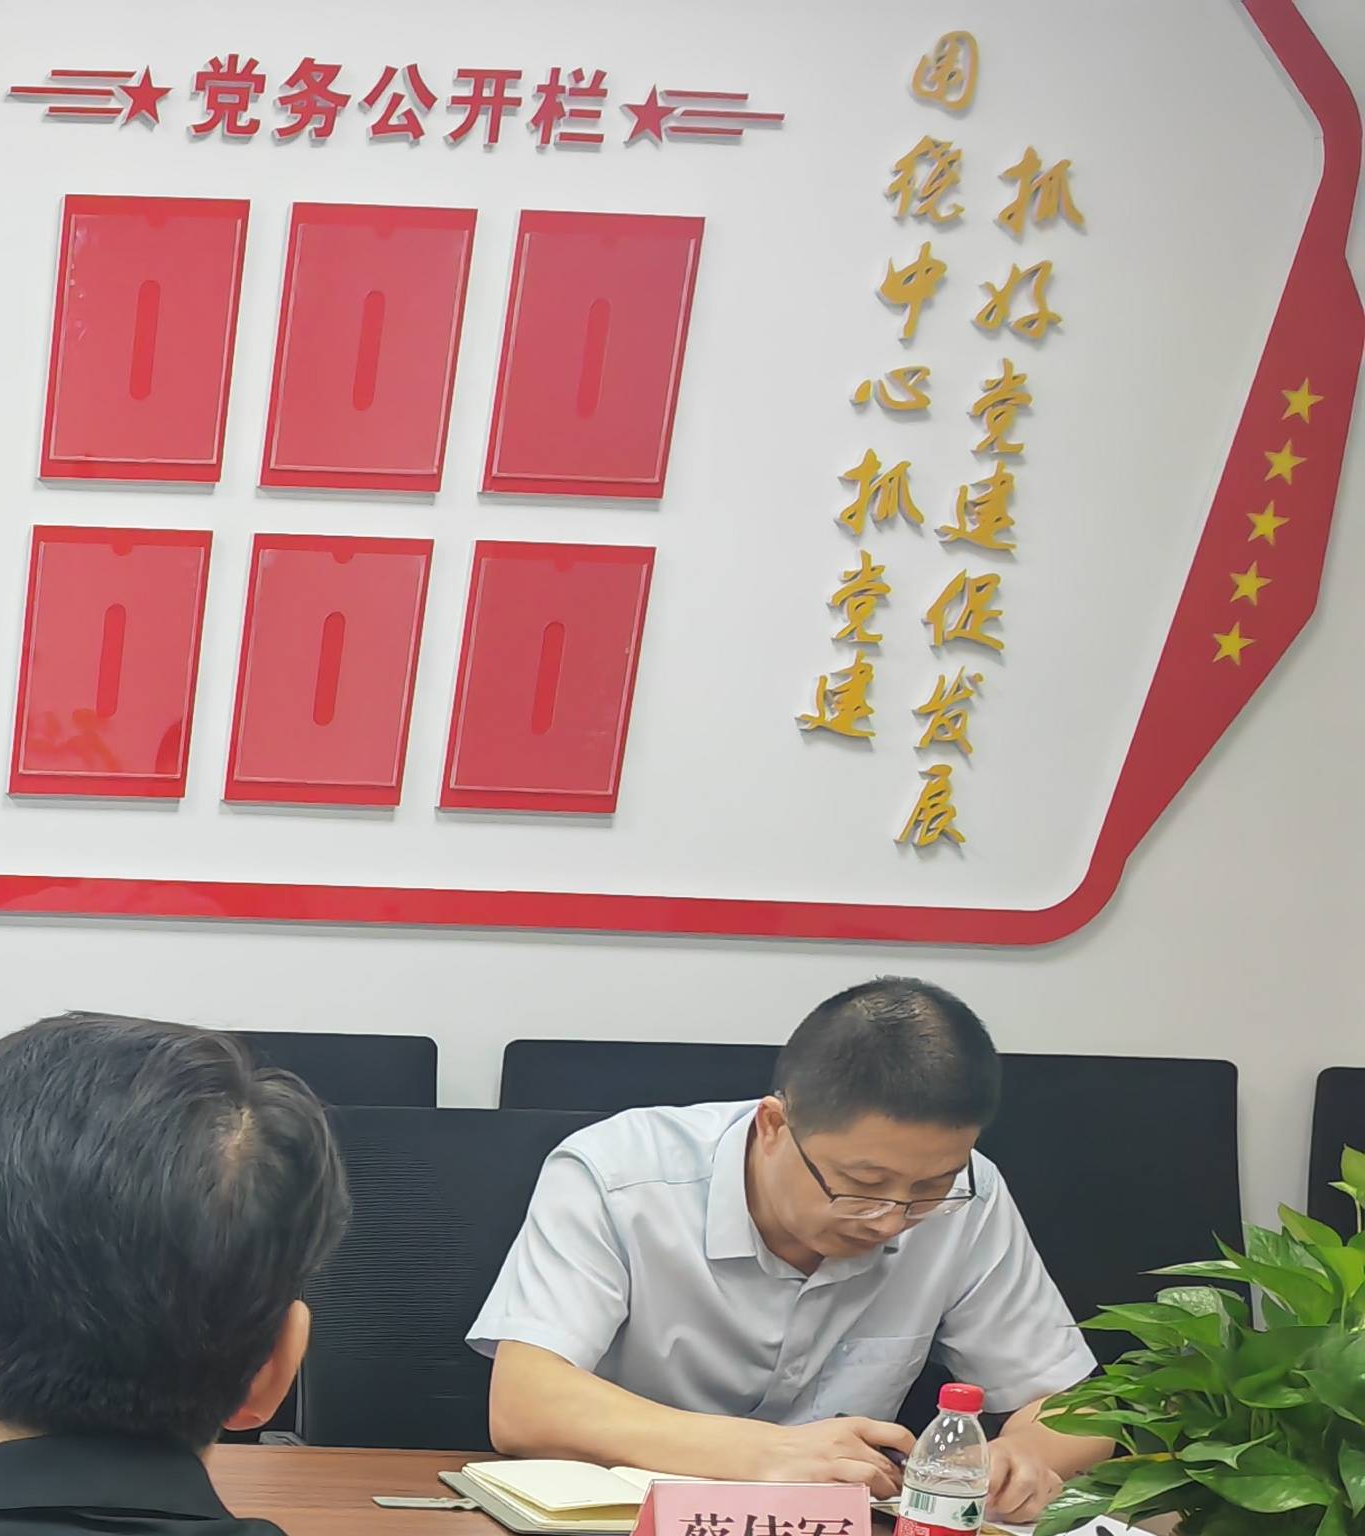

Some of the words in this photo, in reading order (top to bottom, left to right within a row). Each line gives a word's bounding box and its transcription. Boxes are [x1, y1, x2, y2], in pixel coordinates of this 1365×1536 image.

[190, 53, 609, 151] 党务公开栏
[796, 29, 979, 742] 围绕中心抓党建
[895, 146, 1087, 849] 抓好党建促发展
